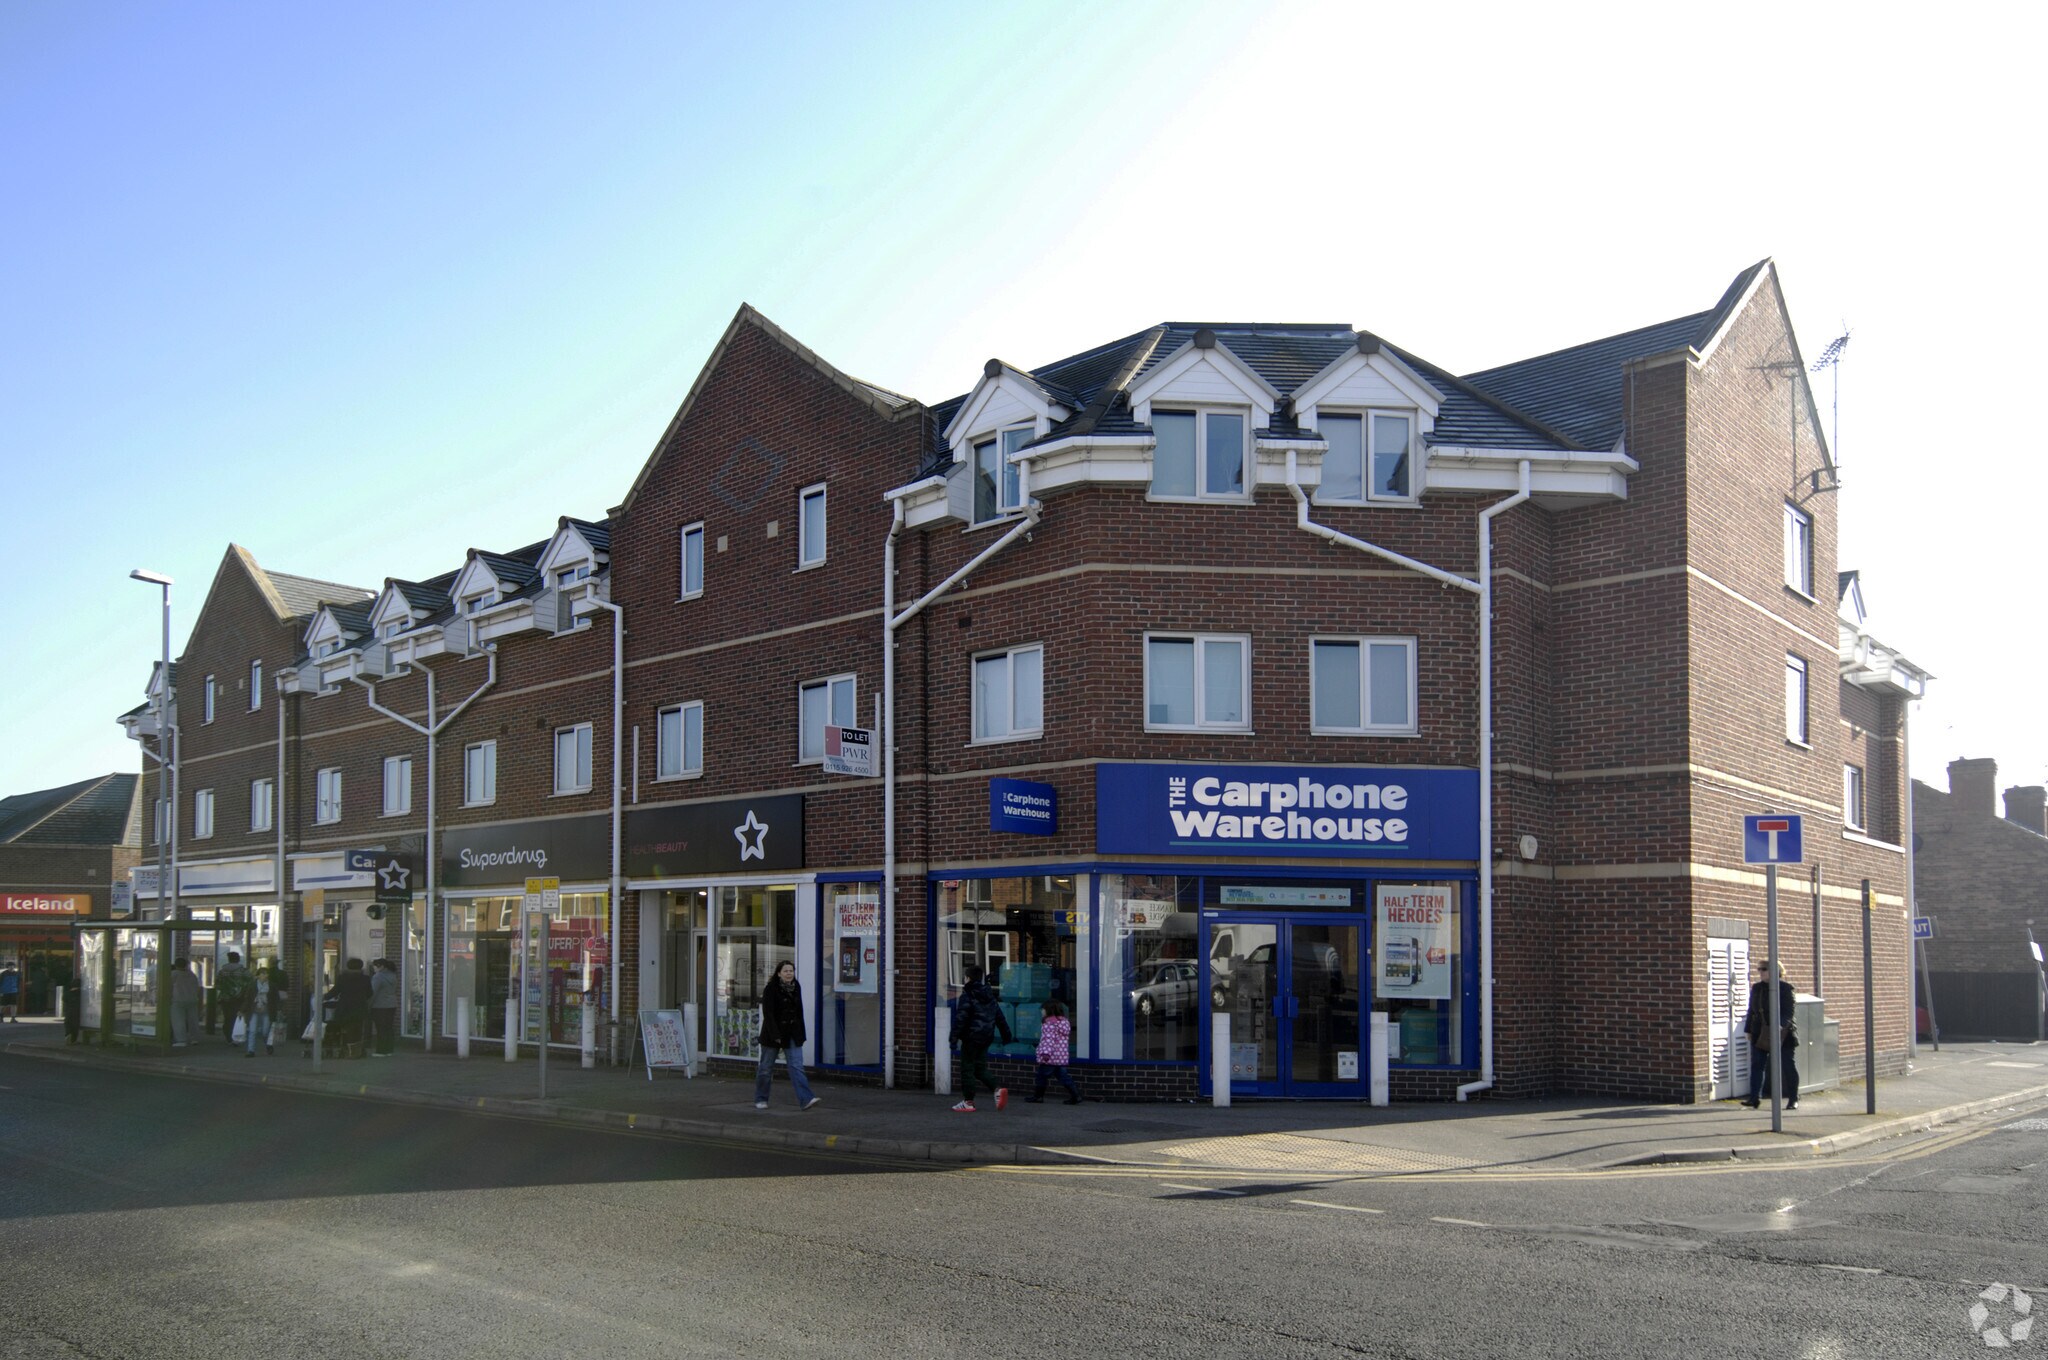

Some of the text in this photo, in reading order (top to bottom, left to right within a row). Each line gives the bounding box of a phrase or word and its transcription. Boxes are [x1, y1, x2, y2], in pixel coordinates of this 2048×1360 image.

[842, 731, 868, 742] TO LET
[842, 747, 868, 760] PWR
[854, 766, 869, 774] 4500
[1007, 792, 1050, 806] Carphone
[1169, 776, 1409, 812] THE Carphone
[1003, 805, 1050, 819] Warehouse
[1169, 810, 1409, 842] Warehouse
[460, 846, 547, 869] Superdrug
[7, 897, 75, 911] Iceland
[839, 902, 875, 914] HALF TERM
[1384, 894, 1444, 908] HALF TERM
[841, 914, 874, 927] HEROES
[1388, 908, 1443, 923] HEROES
